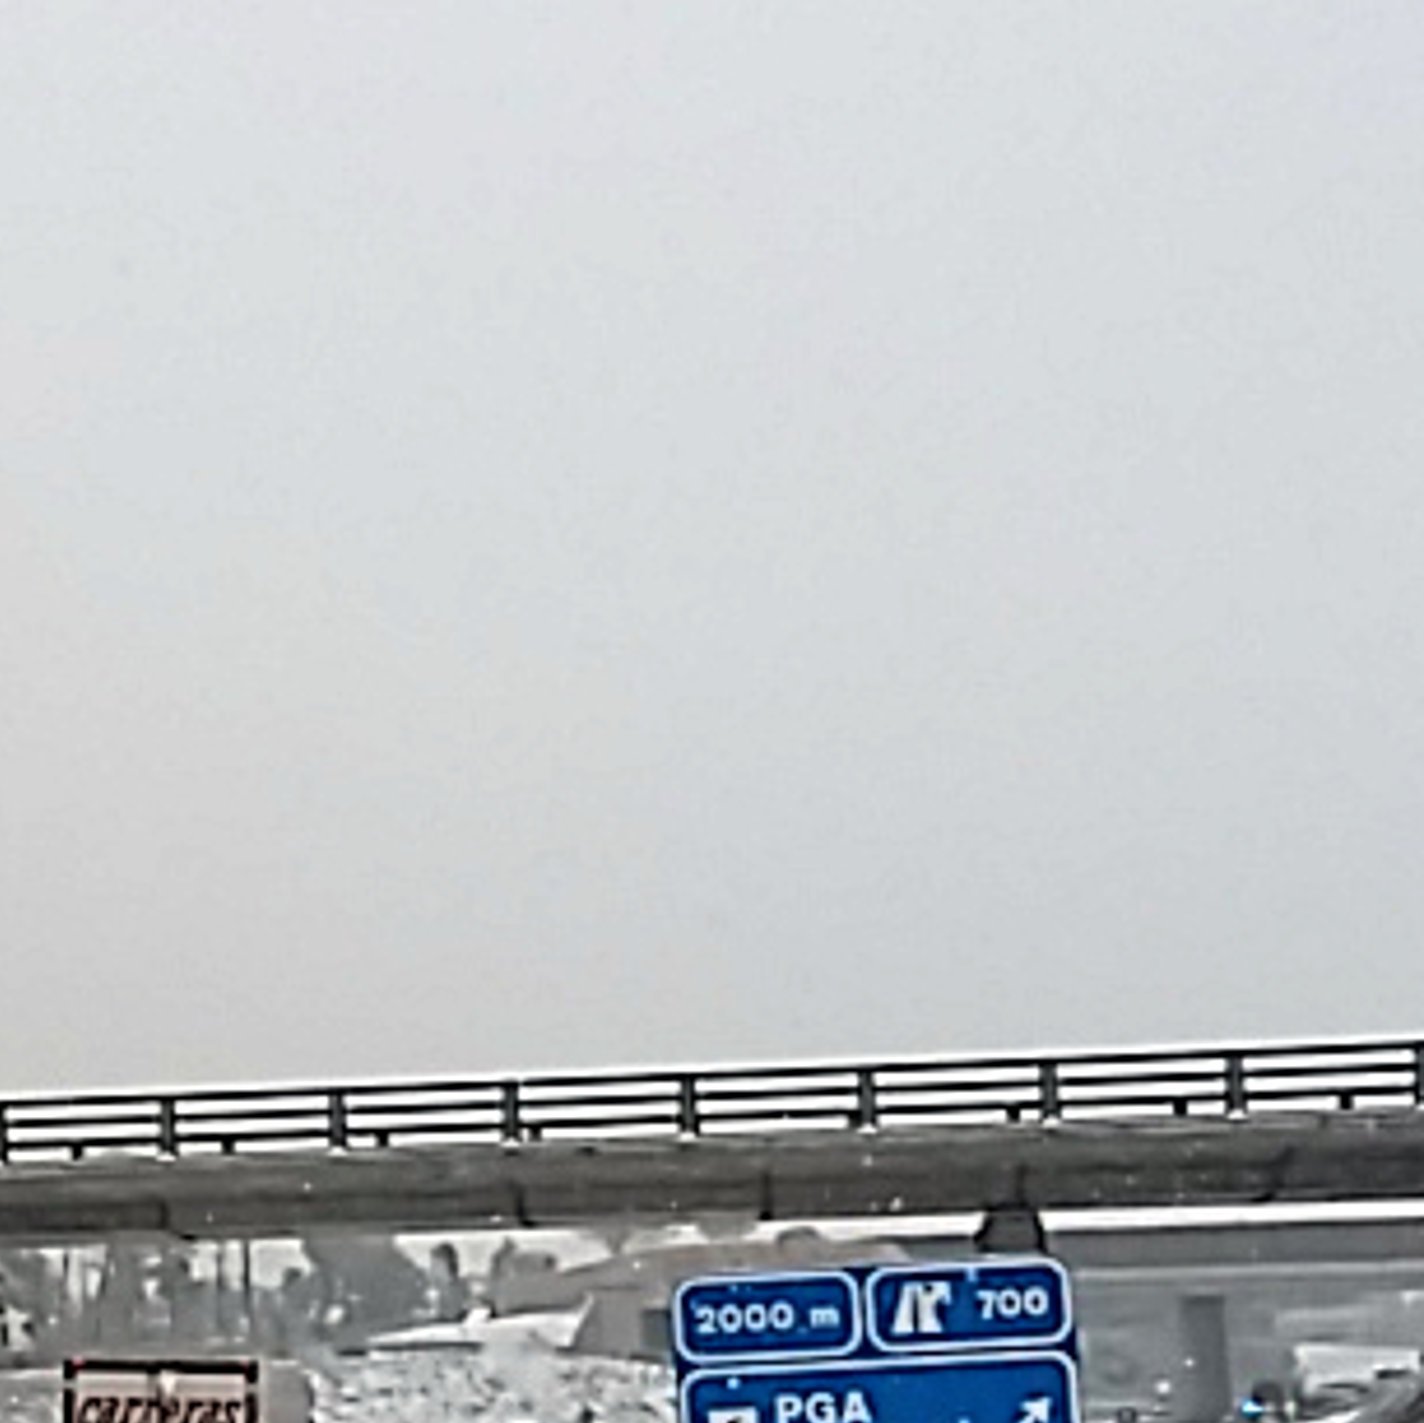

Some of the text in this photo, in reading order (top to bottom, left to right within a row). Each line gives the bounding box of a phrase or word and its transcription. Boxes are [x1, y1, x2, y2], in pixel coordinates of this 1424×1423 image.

[694, 1301, 841, 1334] 2000 m
[976, 1286, 1049, 1319] 700
